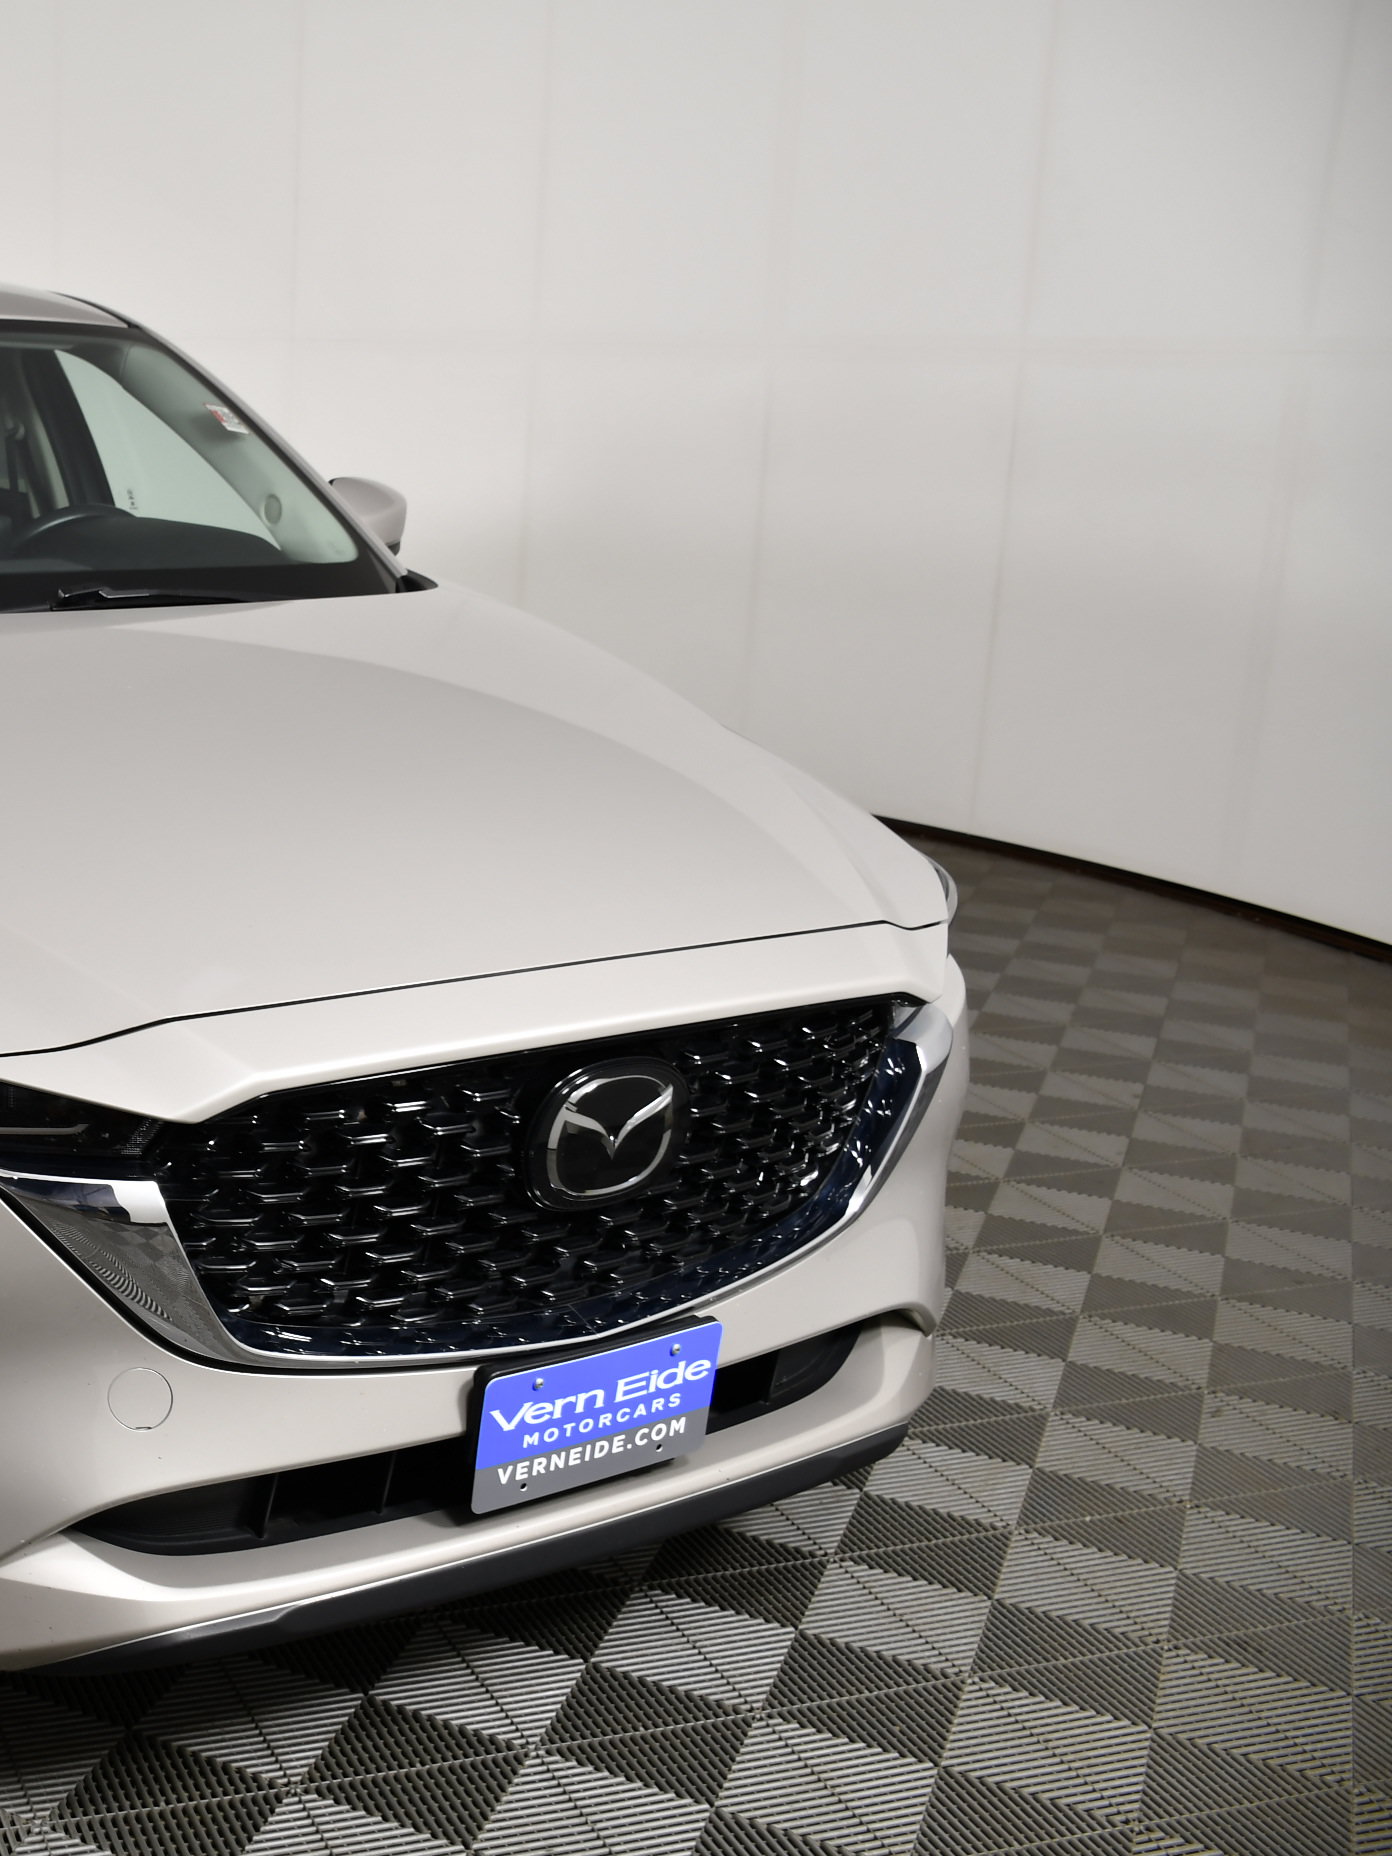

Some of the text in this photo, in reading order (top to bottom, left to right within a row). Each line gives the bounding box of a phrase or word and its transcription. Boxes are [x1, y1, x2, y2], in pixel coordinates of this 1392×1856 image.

[489, 1359, 711, 1431] Vern Eide
[522, 1392, 682, 1448] MOTORCARS
[497, 1416, 687, 1485] VERNEIDE.COM
